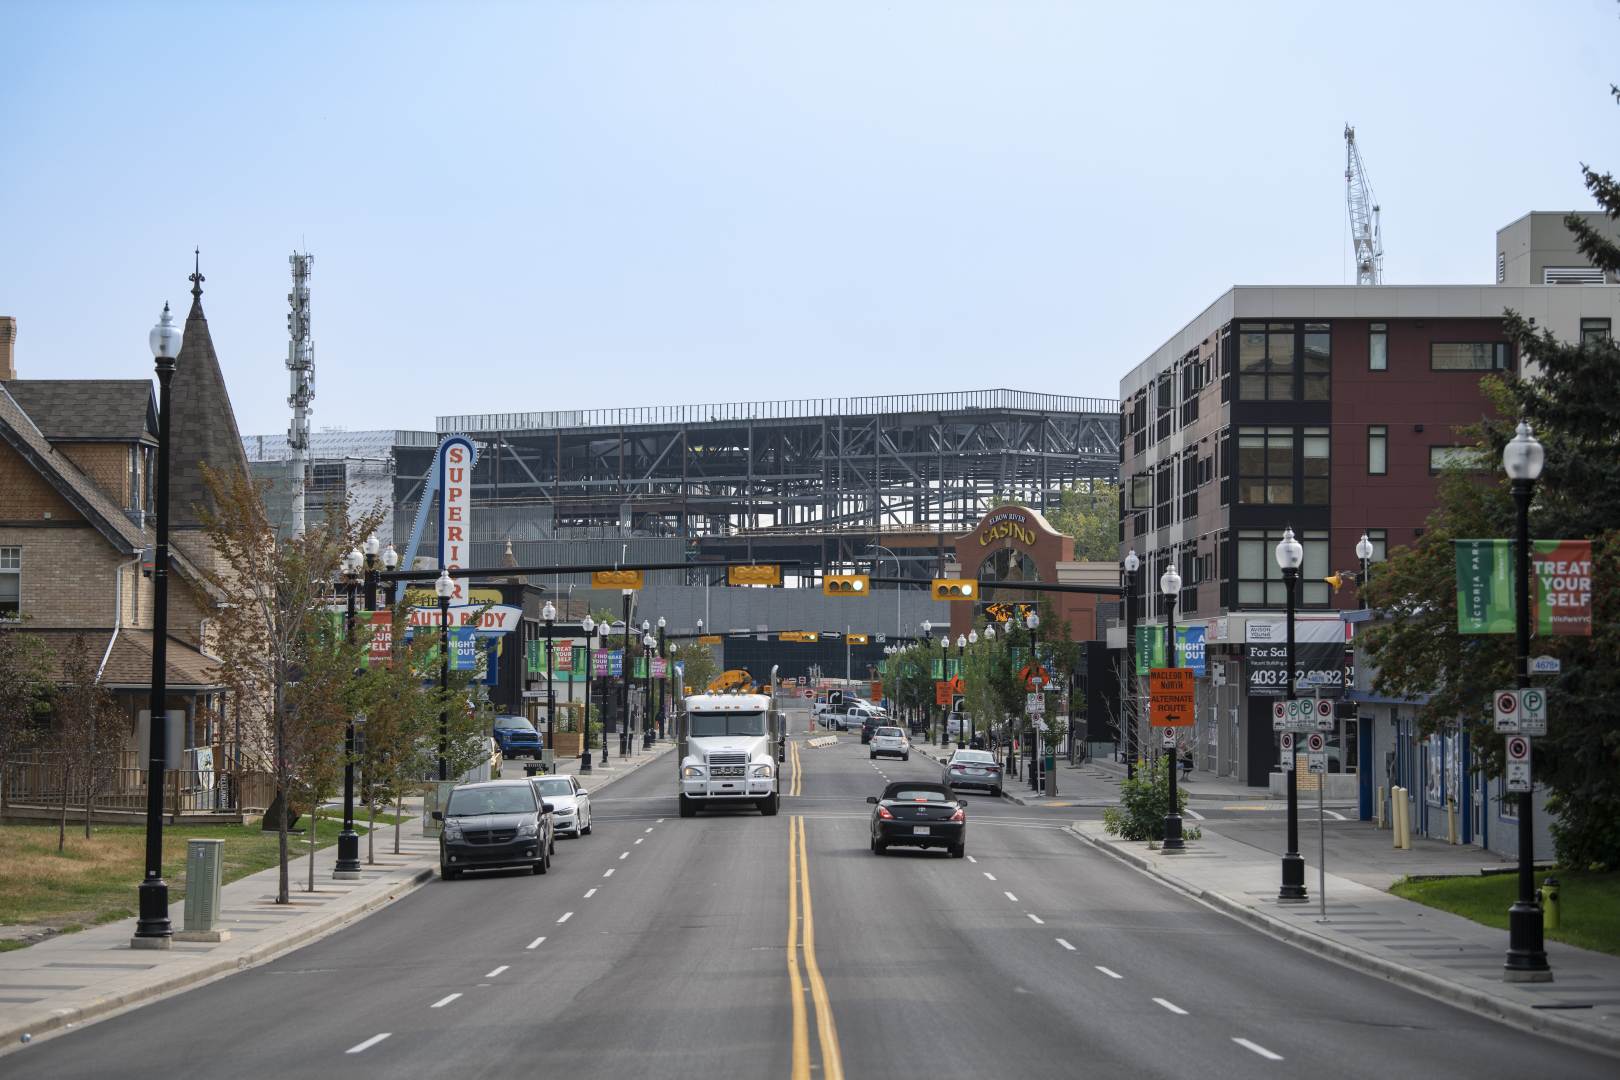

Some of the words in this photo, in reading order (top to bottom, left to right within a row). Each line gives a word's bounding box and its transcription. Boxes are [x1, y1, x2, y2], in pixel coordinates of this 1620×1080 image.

[989, 513, 1008, 525] ELBOW
[1009, 513, 1026, 523] RIVER
[979, 521, 1037, 546] CASINO
[1532, 561, 1592, 575] TREAT
[1541, 577, 1592, 591] YOUR
[1470, 576, 1484, 629] VICTORIA
[1546, 593, 1592, 607] SELF
[409, 611, 454, 627] AUTO
[1198, 635, 1205, 643] A
[457, 648, 476, 656] OUT
[1175, 643, 1205, 651] NIGHT
[1250, 647, 1268, 657] For
[1270, 647, 1288, 657] Sal
[1185, 651, 1205, 659] OUT
[1250, 670, 1276, 685] 403
[1279, 670, 1305, 684] 22
[1160, 681, 1184, 689] NORTH
